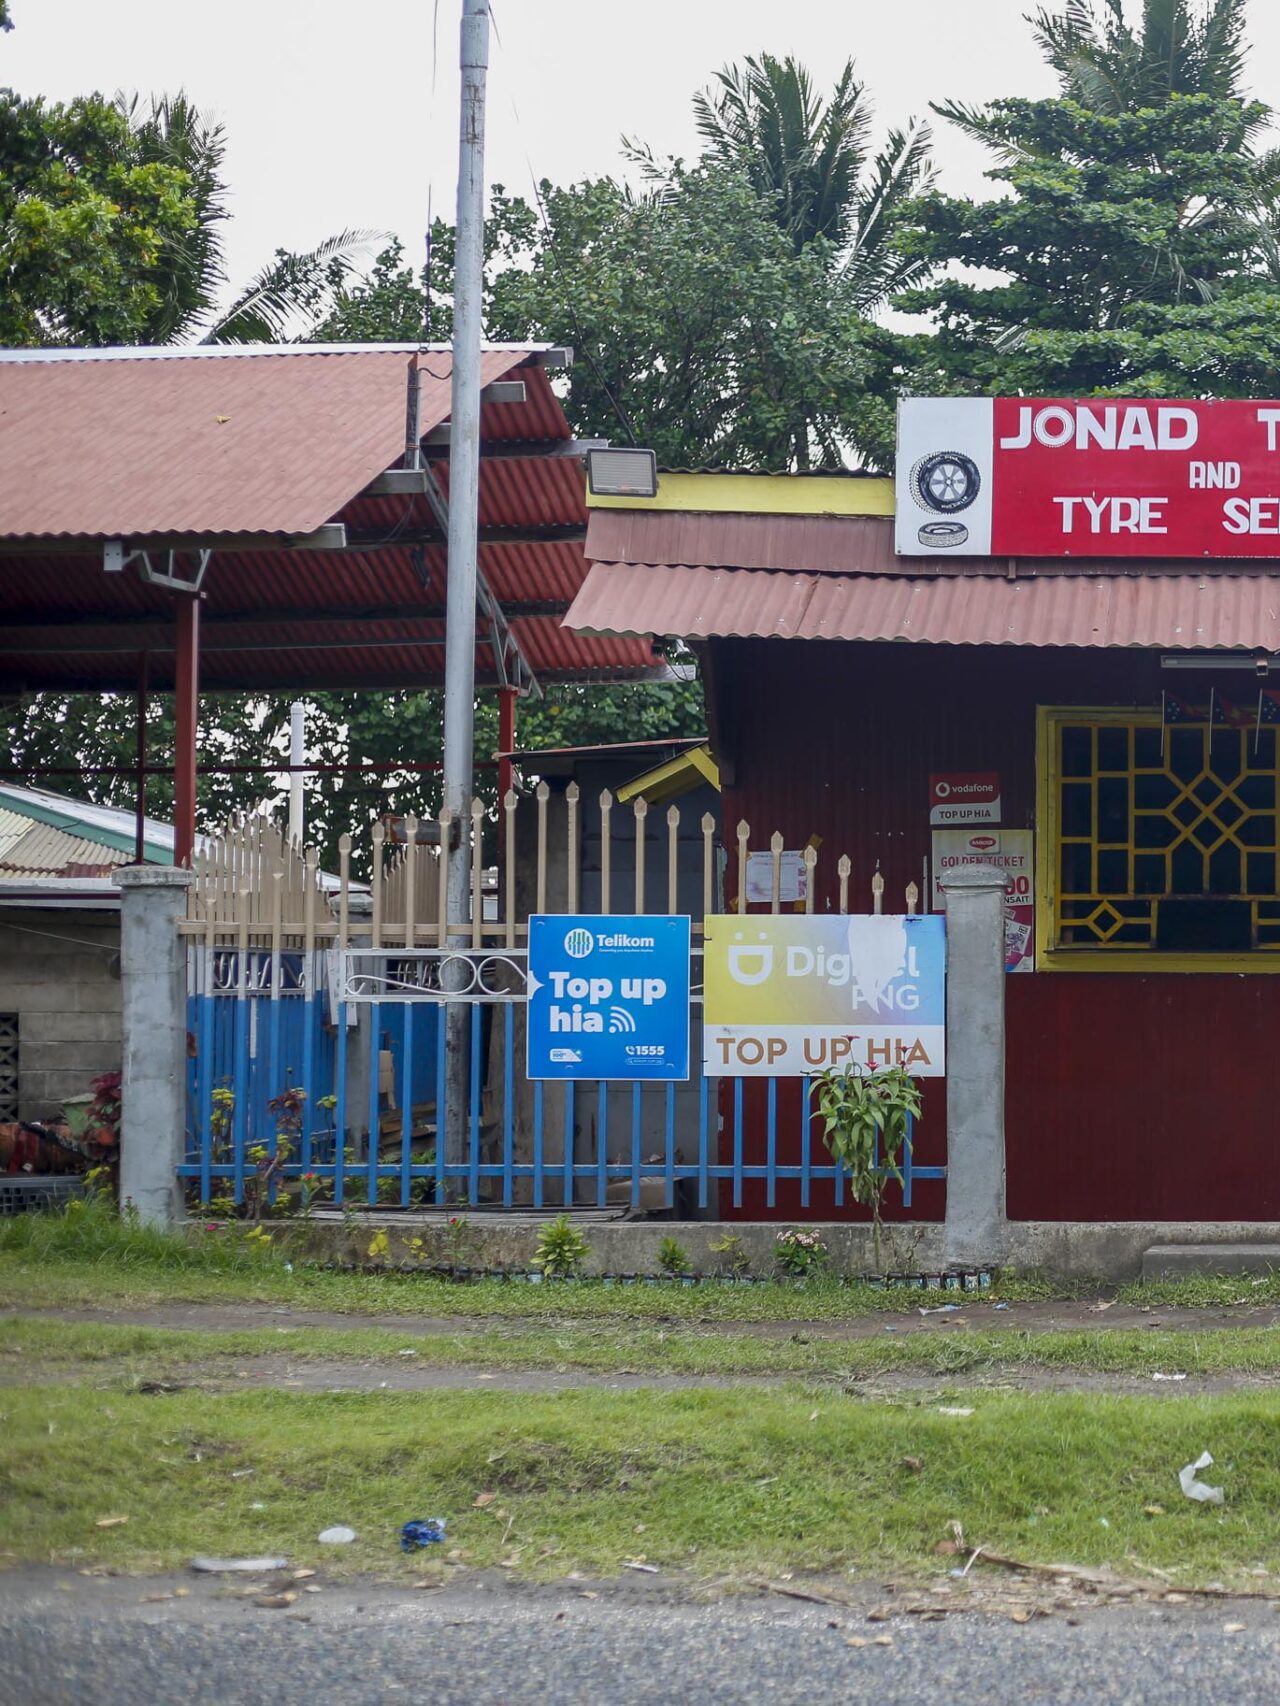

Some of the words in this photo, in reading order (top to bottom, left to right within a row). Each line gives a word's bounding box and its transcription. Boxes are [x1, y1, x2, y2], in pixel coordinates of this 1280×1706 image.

[1000, 407, 1199, 450] JONAD
[1189, 461, 1241, 490] AND
[1053, 497, 1168, 535] TYRE
[952, 783, 994, 794] vodafone
[939, 811, 958, 820] TOP
[960, 811, 973, 819] UP
[974, 809, 991, 818] HIA
[987, 856, 1025, 867] TICKET
[596, 934, 654, 947] Telikom
[787, 946, 920, 985] Digl
[549, 972, 612, 1005] Top
[620, 978, 667, 1005] up
[549, 1004, 603, 1032] hia
[635, 1045, 665, 1055] 1555
[716, 1037, 788, 1065] TOP
[803, 1038, 851, 1065] UP
[867, 1038, 931, 1065] HIA
